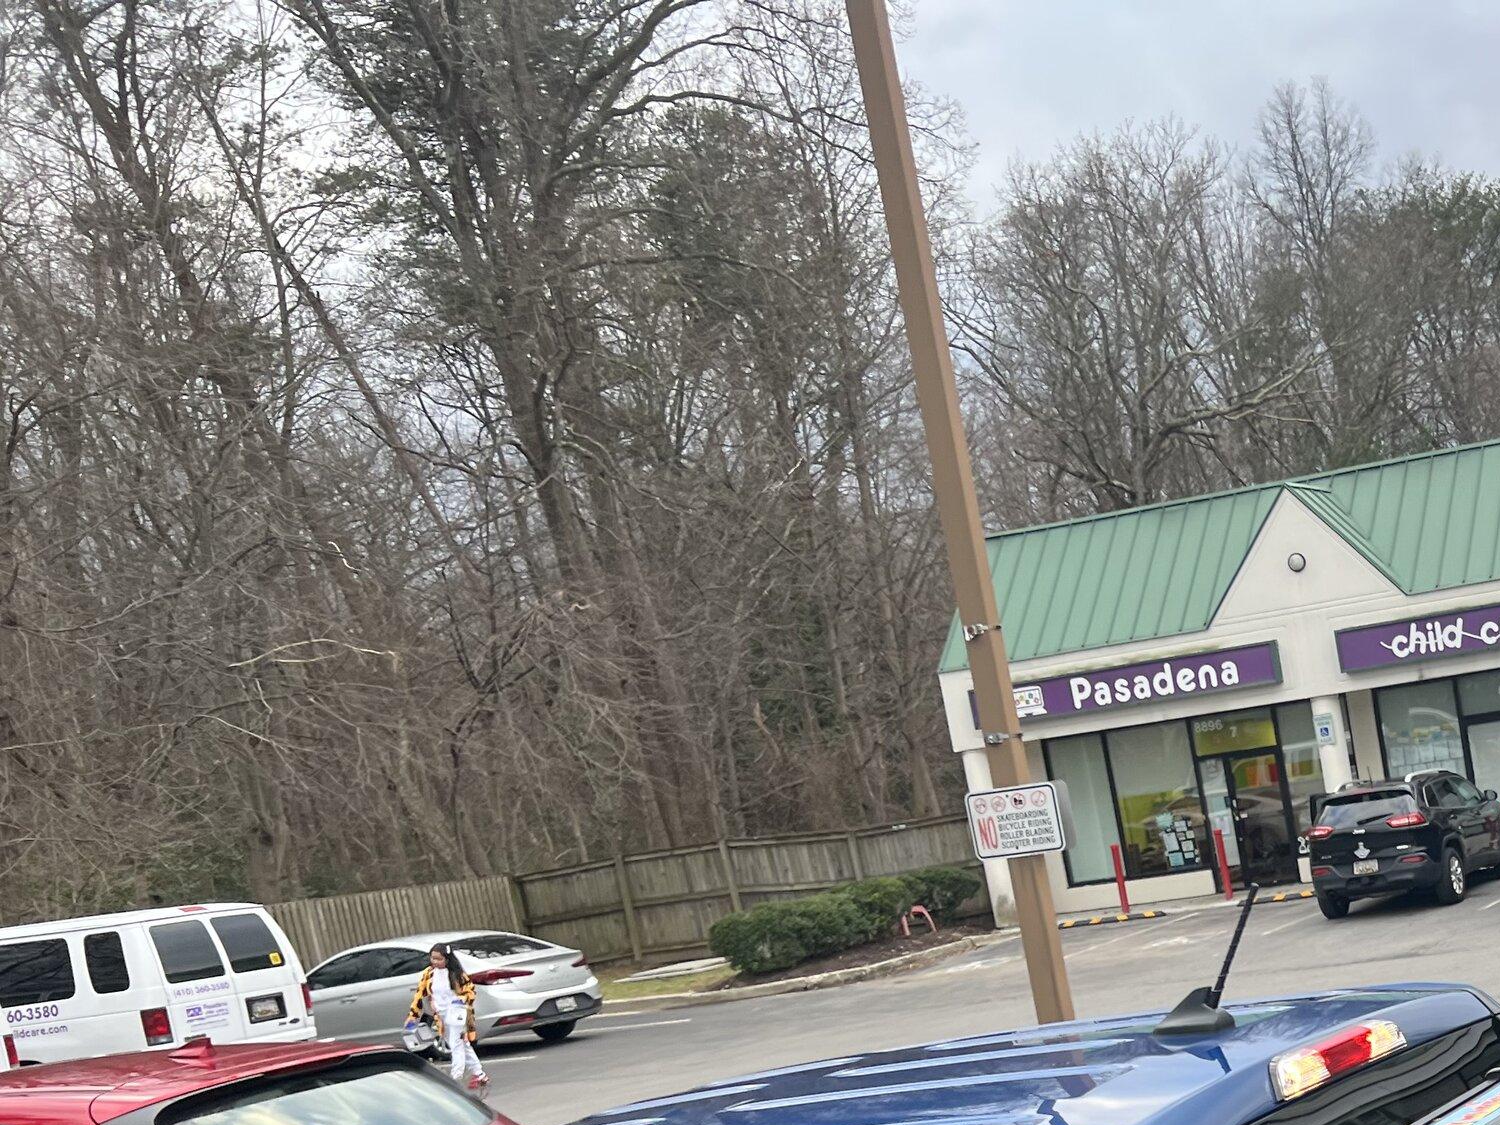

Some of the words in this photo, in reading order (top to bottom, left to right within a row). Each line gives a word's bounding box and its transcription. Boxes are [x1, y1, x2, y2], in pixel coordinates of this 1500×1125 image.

[1380, 617, 1466, 658] child
[1069, 660, 1240, 710] Pasadena
[1193, 718, 1223, 733] 8896
[997, 809, 1049, 822] SKATEBOARDING
[998, 820, 1026, 832] BICYCLE
[1028, 817, 1052, 829] RIDING
[978, 816, 998, 850] NO
[1000, 830, 1025, 840] ROLLER
[1026, 826, 1054, 837] BLADING
[1001, 838, 1032, 849] SCOOTER
[1032, 835, 1056, 846] RIDING
[6, 1004, 59, 1023] 60-3580
[13, 1024, 69, 1039] ildcare.com
